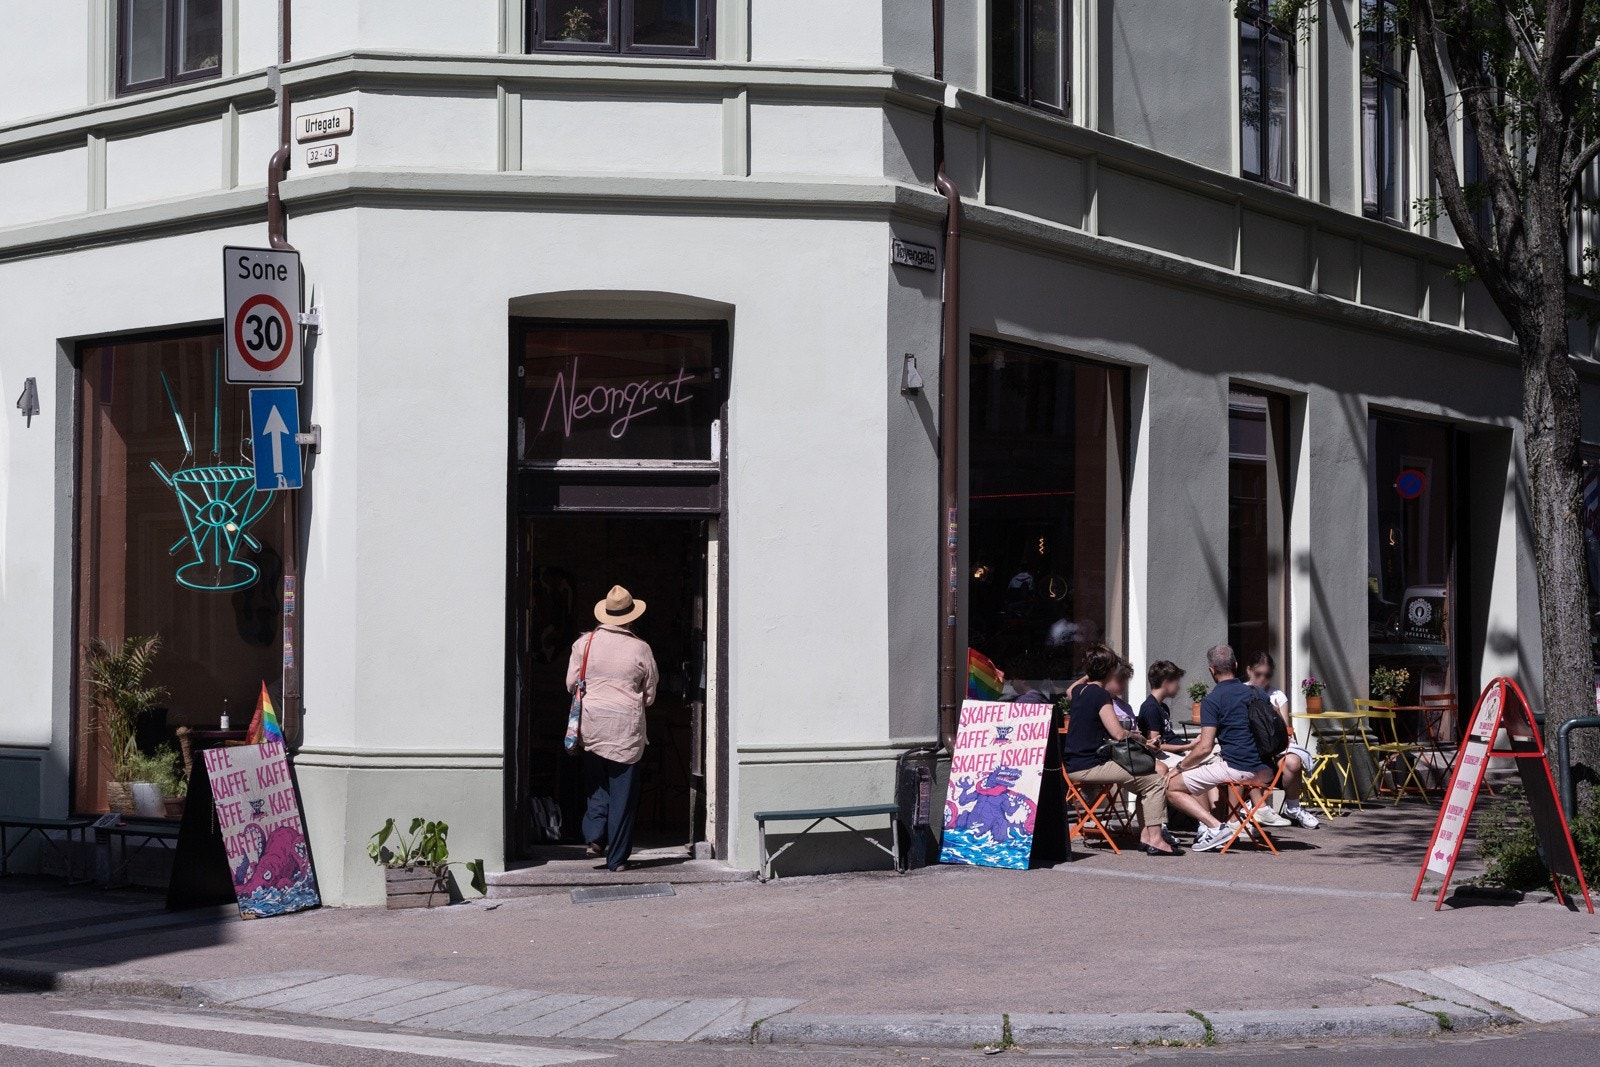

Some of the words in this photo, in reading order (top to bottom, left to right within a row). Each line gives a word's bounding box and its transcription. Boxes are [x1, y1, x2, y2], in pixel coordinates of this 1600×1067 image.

[305, 115, 340, 134] Urtegata
[238, 256, 288, 282] Sone
[245, 314, 283, 352] 30
[541, 356, 695, 438] Neongrut
[211, 770, 250, 800] KAFFE
